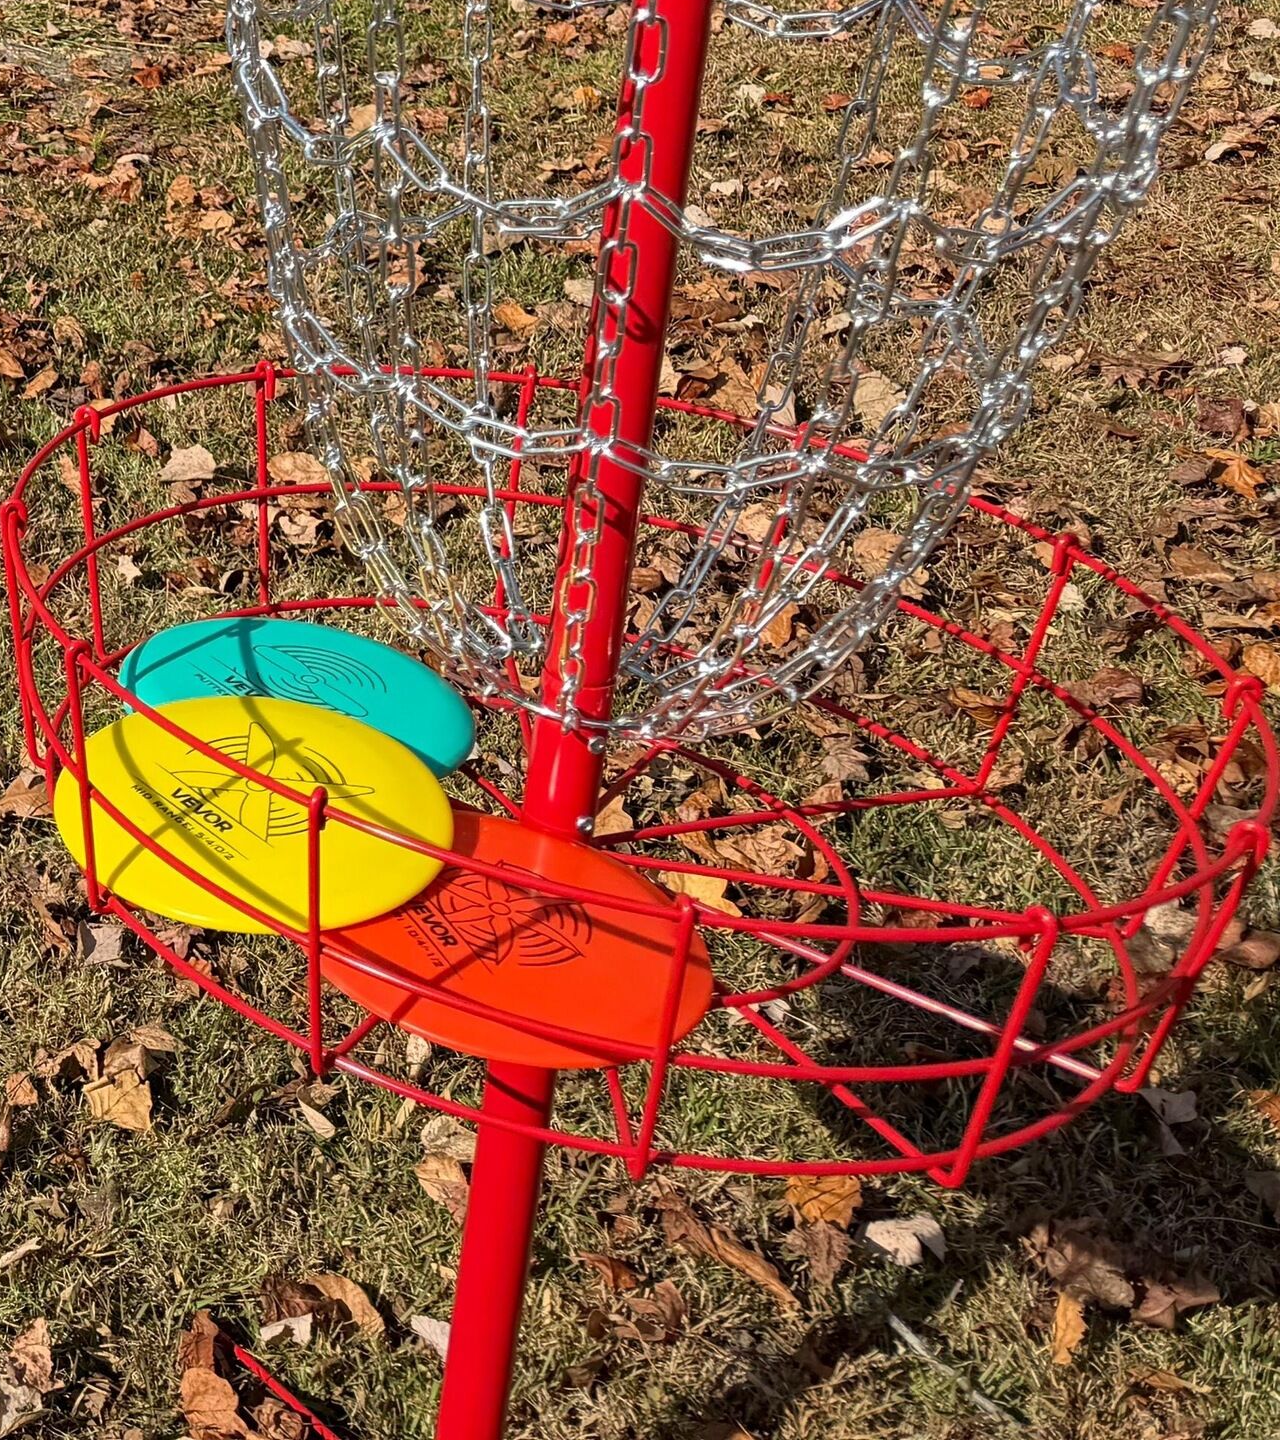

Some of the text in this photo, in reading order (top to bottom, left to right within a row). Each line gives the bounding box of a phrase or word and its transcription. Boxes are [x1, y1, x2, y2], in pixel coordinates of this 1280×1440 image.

[224, 674, 265, 697] VEV
[130, 784, 153, 800] MID
[170, 787, 233, 833] VEVOR
